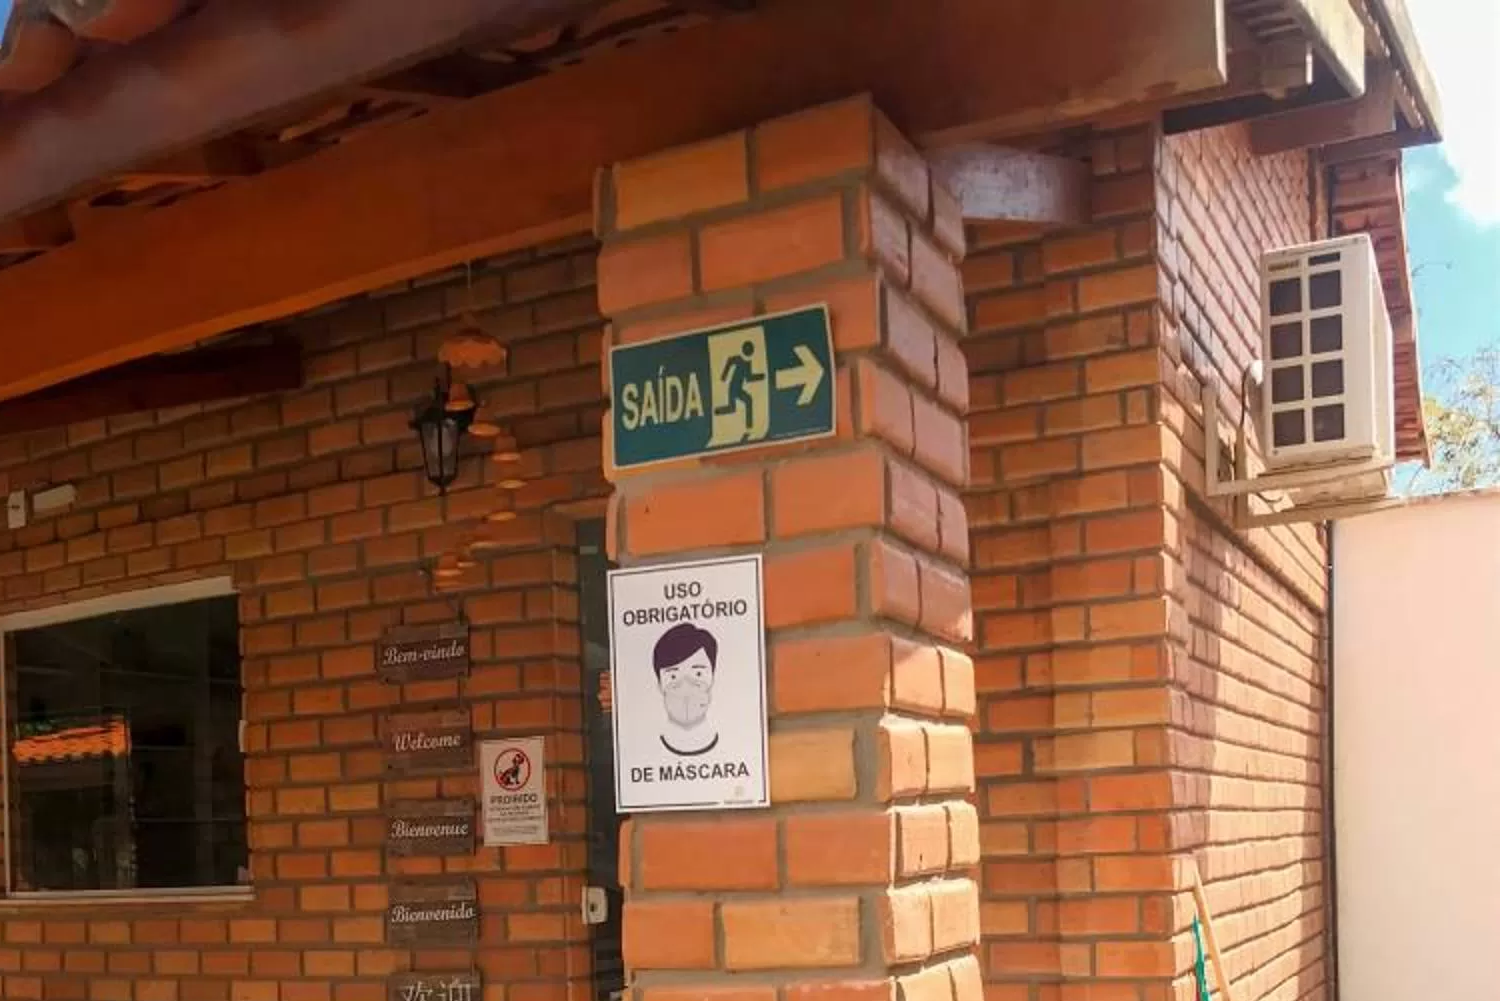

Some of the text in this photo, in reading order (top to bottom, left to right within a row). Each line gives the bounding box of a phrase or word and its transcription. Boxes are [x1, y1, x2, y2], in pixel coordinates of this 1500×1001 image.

[621, 365, 704, 430] SAÍDA
[664, 581, 701, 600] USO
[622, 599, 748, 626] OBRIGATÓRIO
[383, 640, 465, 665] Bem-vindo
[392, 732, 461, 752] Welcome
[631, 761, 750, 783] DE MÁSCARA
[391, 819, 469, 838] Bienvenue
[391, 902, 476, 923] Bienvenido
